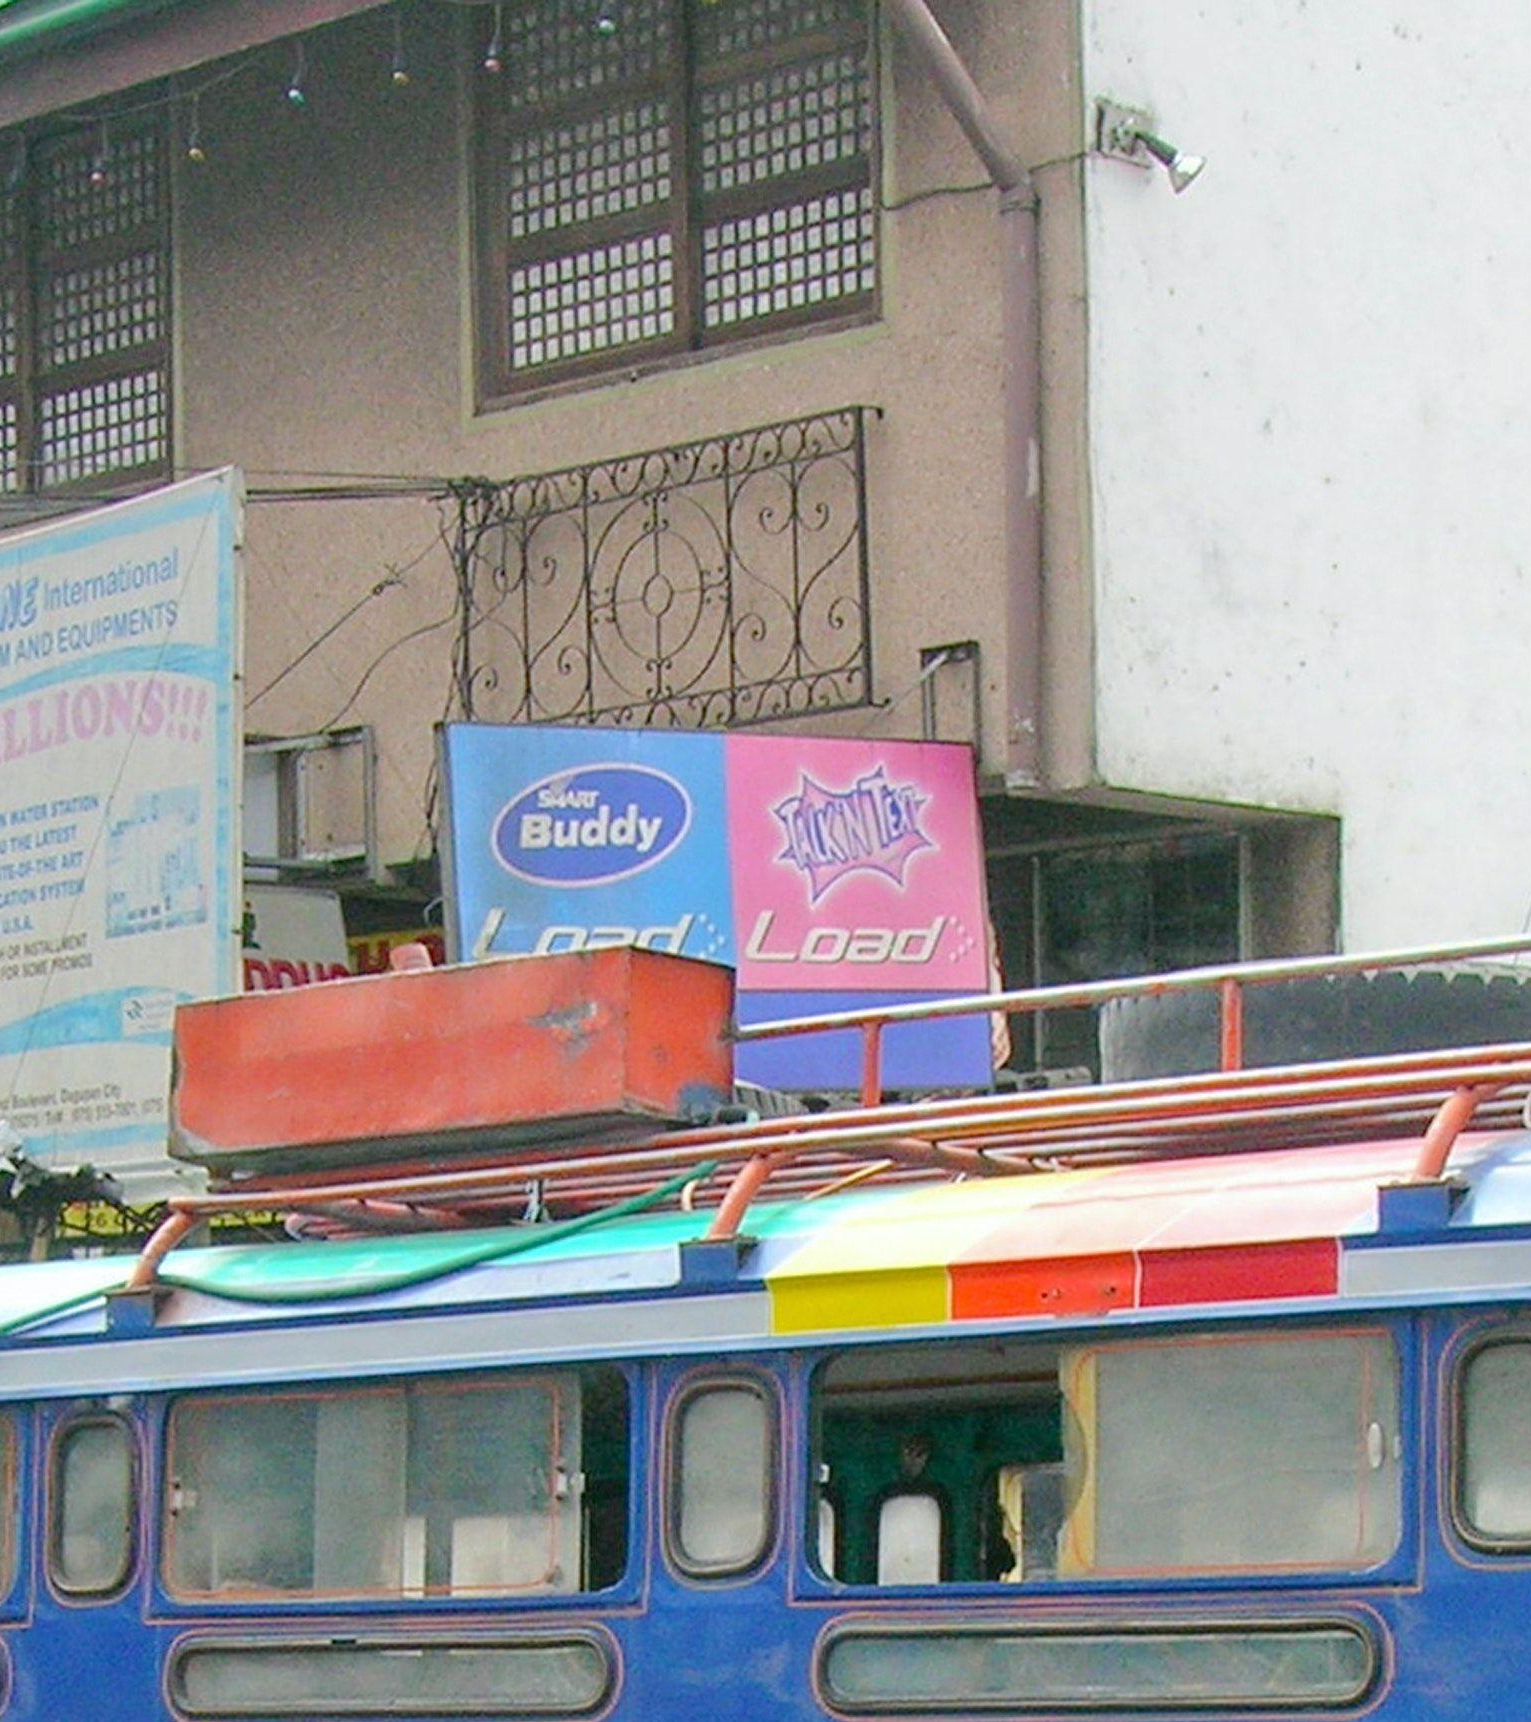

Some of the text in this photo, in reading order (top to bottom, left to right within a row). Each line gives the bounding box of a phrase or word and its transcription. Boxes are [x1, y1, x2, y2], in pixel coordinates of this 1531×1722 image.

[41, 547, 179, 612] International
[16, 631, 54, 661] AND
[56, 600, 179, 650] EQUIPMENTS
[537, 787, 601, 810] SMART
[10, 833, 33, 852] THE
[519, 803, 663, 852] Buddy
[744, 910, 946, 965] Load
